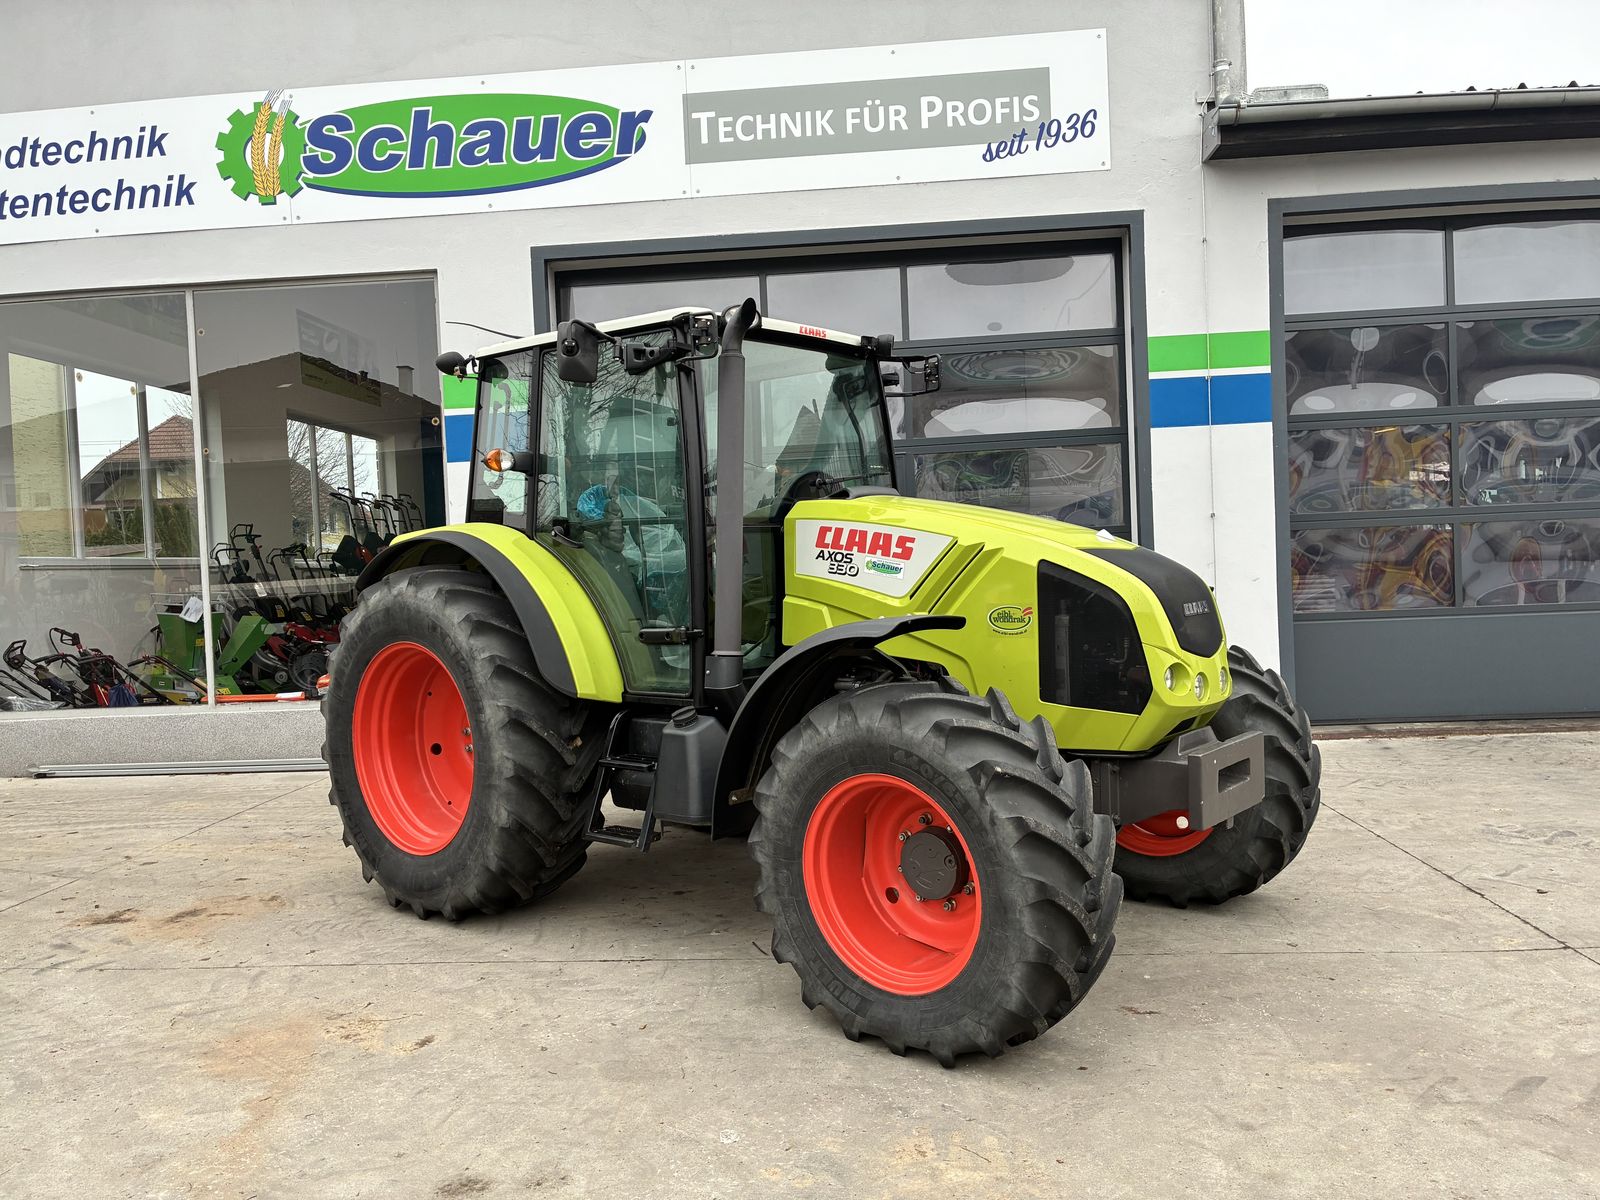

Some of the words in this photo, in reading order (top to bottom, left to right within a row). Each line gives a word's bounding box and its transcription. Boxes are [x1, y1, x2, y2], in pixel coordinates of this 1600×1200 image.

[0, 126, 169, 170] dtechnik
[302, 107, 653, 175] Schauer
[982, 127, 1028, 162] seit
[1036, 109, 1098, 151] 1936
[0, 174, 197, 221] tentechnik
[799, 325, 827, 338] CLAAS
[815, 526, 916, 560] CLAAS
[815, 550, 854, 564] AXOS
[828, 562, 859, 577] 330
[872, 560, 903, 572] Schauer
